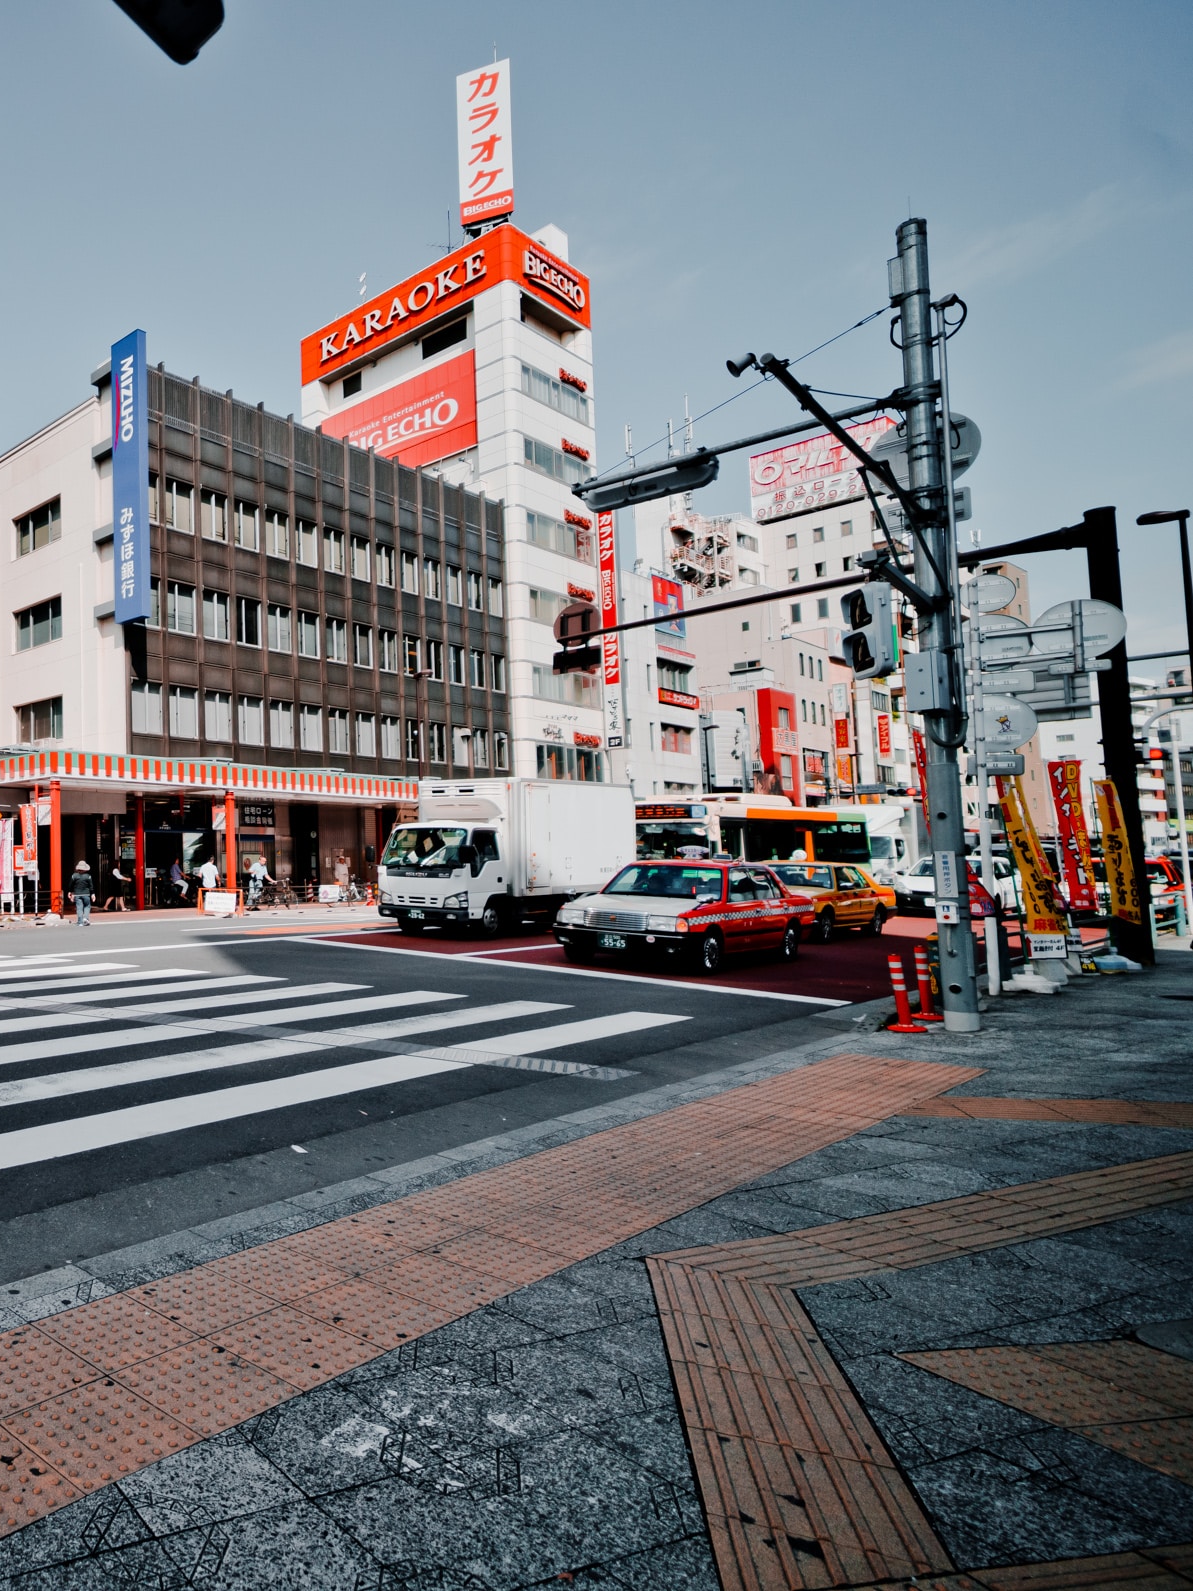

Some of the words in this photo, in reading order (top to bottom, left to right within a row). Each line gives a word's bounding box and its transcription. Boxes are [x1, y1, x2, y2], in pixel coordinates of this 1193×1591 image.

[466, 72, 504, 197] カラオケ
[463, 202, 483, 217] BIG
[483, 195, 512, 210] ECHO
[524, 250, 550, 281] BIG
[550, 268, 585, 308] ECHO
[320, 250, 488, 363] KARAOKE
[120, 355, 134, 442] MIZUHO
[349, 420, 380, 438] Karaoke
[382, 391, 445, 423] Entertainment
[387, 398, 459, 440] ECHO
[774, 471, 861, 502] 振込ローン
[120, 508, 135, 599] みずほ銀行
[600, 514, 614, 561] カラオケ
[602, 570, 611, 586] BIG
[604, 587, 613, 610] ECHO
[604, 632, 620, 679] カラオケ
[609, 738, 621, 746] 2F
[244, 806, 273, 815] 住宅ローン
[604, 939, 626, 948] 55-65
